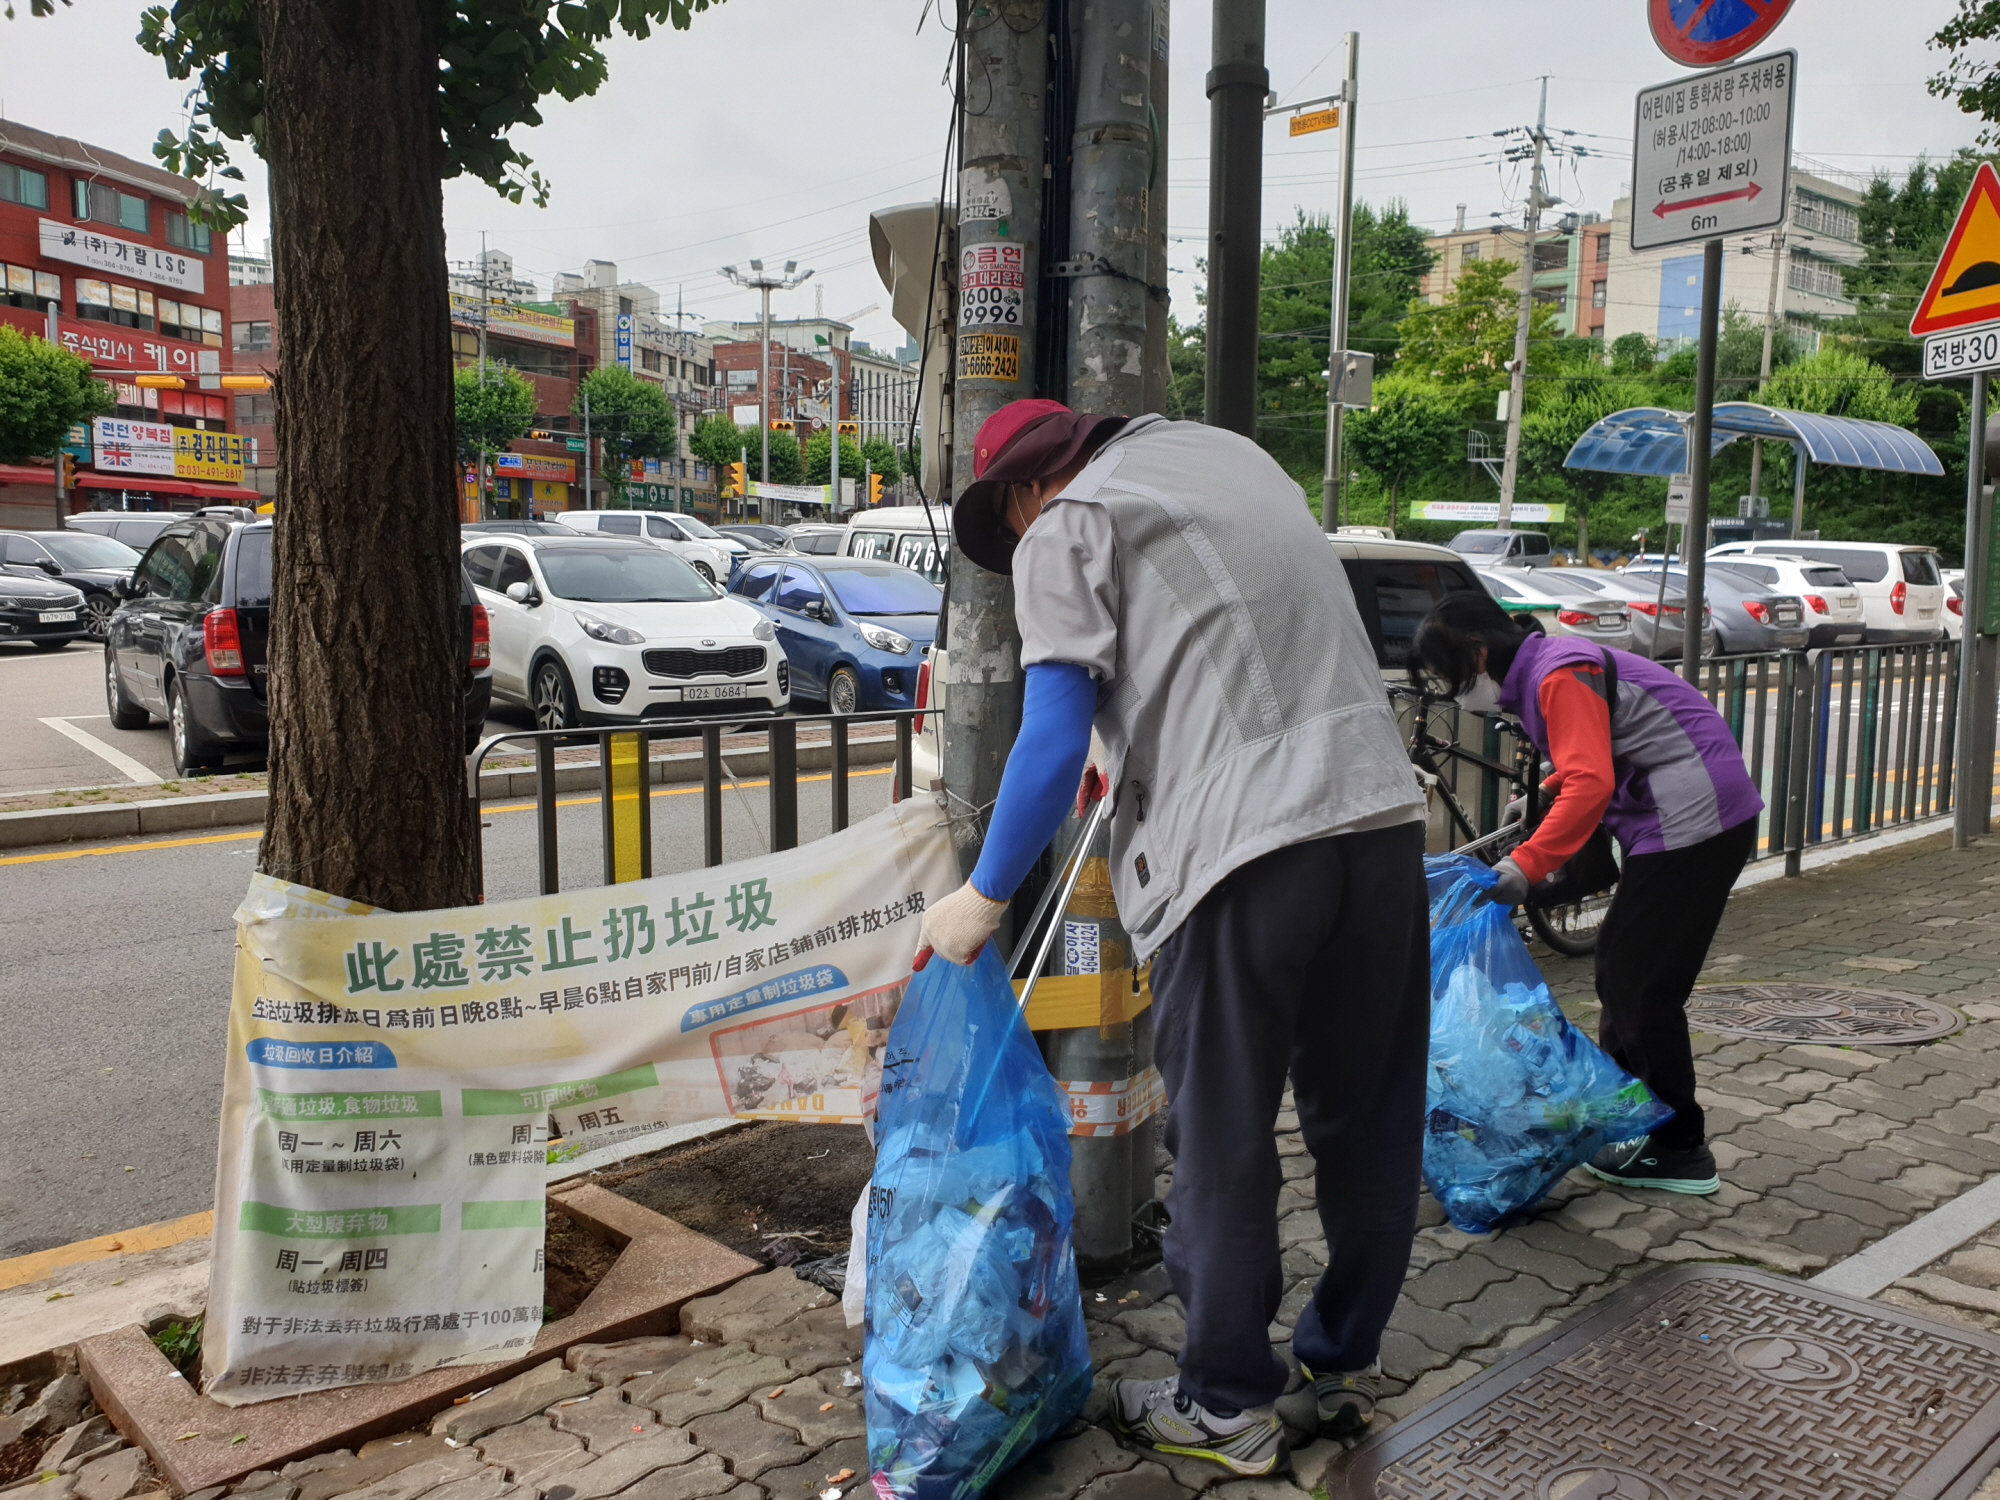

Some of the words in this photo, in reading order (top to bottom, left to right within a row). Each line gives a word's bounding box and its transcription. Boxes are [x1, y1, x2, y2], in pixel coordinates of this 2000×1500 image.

[1643, 89, 1685, 121] 어린이집
[1690, 76, 1734, 110] 통학차량
[1739, 63, 1786, 98] 주차허용
[1676, 131, 1751, 168] /14:00~18:00)
[1659, 168, 1710, 195] (공휴일
[1717, 158, 1758, 180] 제외)
[1691, 215, 1717, 231] 6m
[155, 253, 186, 275] LSC
[978, 246, 1022, 264] 금연
[989, 263, 1020, 271] SMOKING
[980, 271, 1022, 288] 대리운전
[962, 287, 1002, 307] 1600
[963, 305, 1018, 325] 9996
[63, 331, 133, 363] 주식회사
[986, 336, 1018, 356] 이사이사
[102, 422, 129, 438] 런던
[132, 425, 171, 443] 양복점
[187, 468, 242, 480] 031-491-5817
[689, 688, 709, 699] 02소
[715, 686, 740, 698] 0684
[346, 877, 778, 994] 此處禁止扔垃圾
[262, 1043, 373, 1064] 垃圾回收日介紹
[520, 1082, 599, 1108] 可回收物
[278, 1130, 323, 1153] 周一
[353, 1129, 402, 1153] 周六
[339, 1248, 388, 1272] 周四
